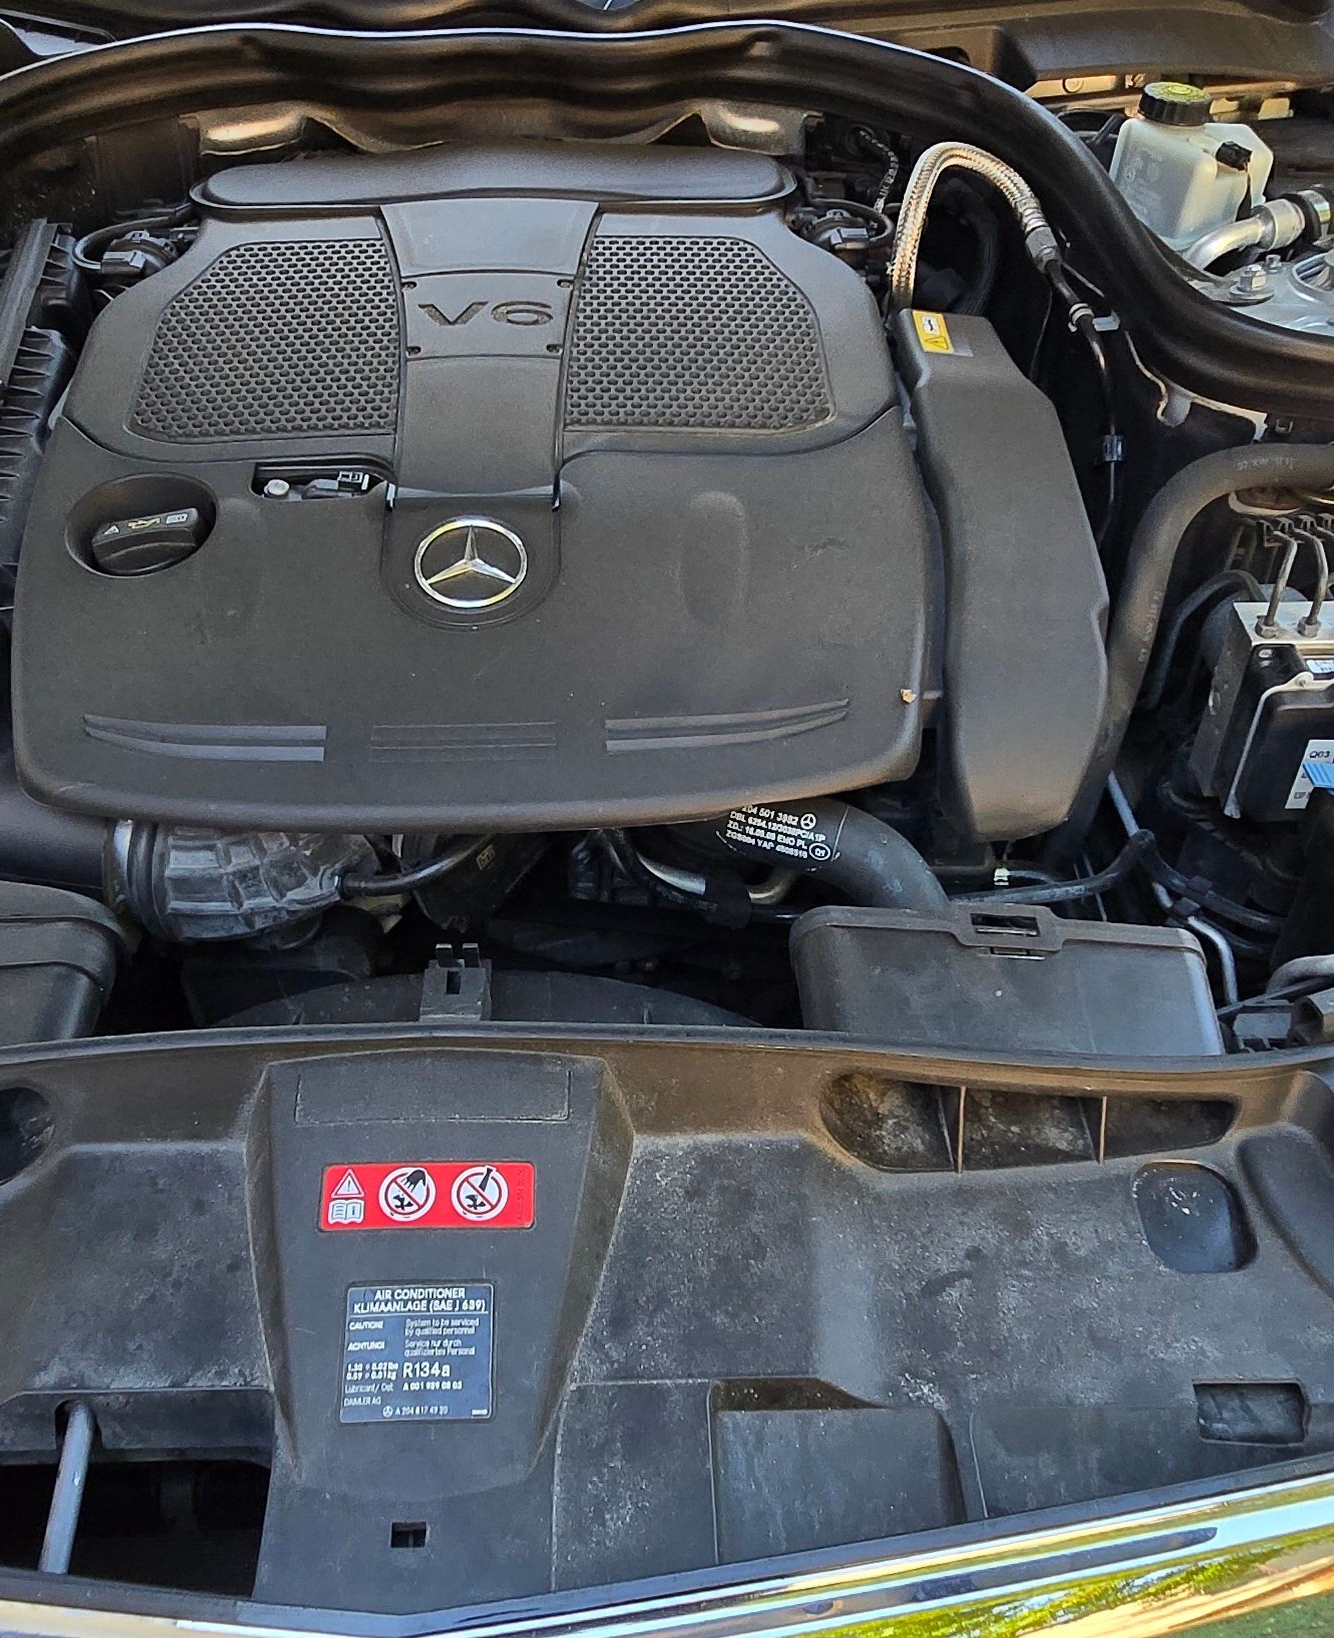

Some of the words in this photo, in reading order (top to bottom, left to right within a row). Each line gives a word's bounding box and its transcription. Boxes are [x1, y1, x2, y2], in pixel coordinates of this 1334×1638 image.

[417, 300, 554, 326] V6
[759, 808, 775, 820] 501
[374, 1289, 392, 1300] AIR
[394, 1287, 466, 1300] CONDITIONER
[353, 1301, 427, 1313] KLIMAANLAGE
[429, 1300, 453, 1313] (SAE
[402, 1361, 451, 1379] R134a
